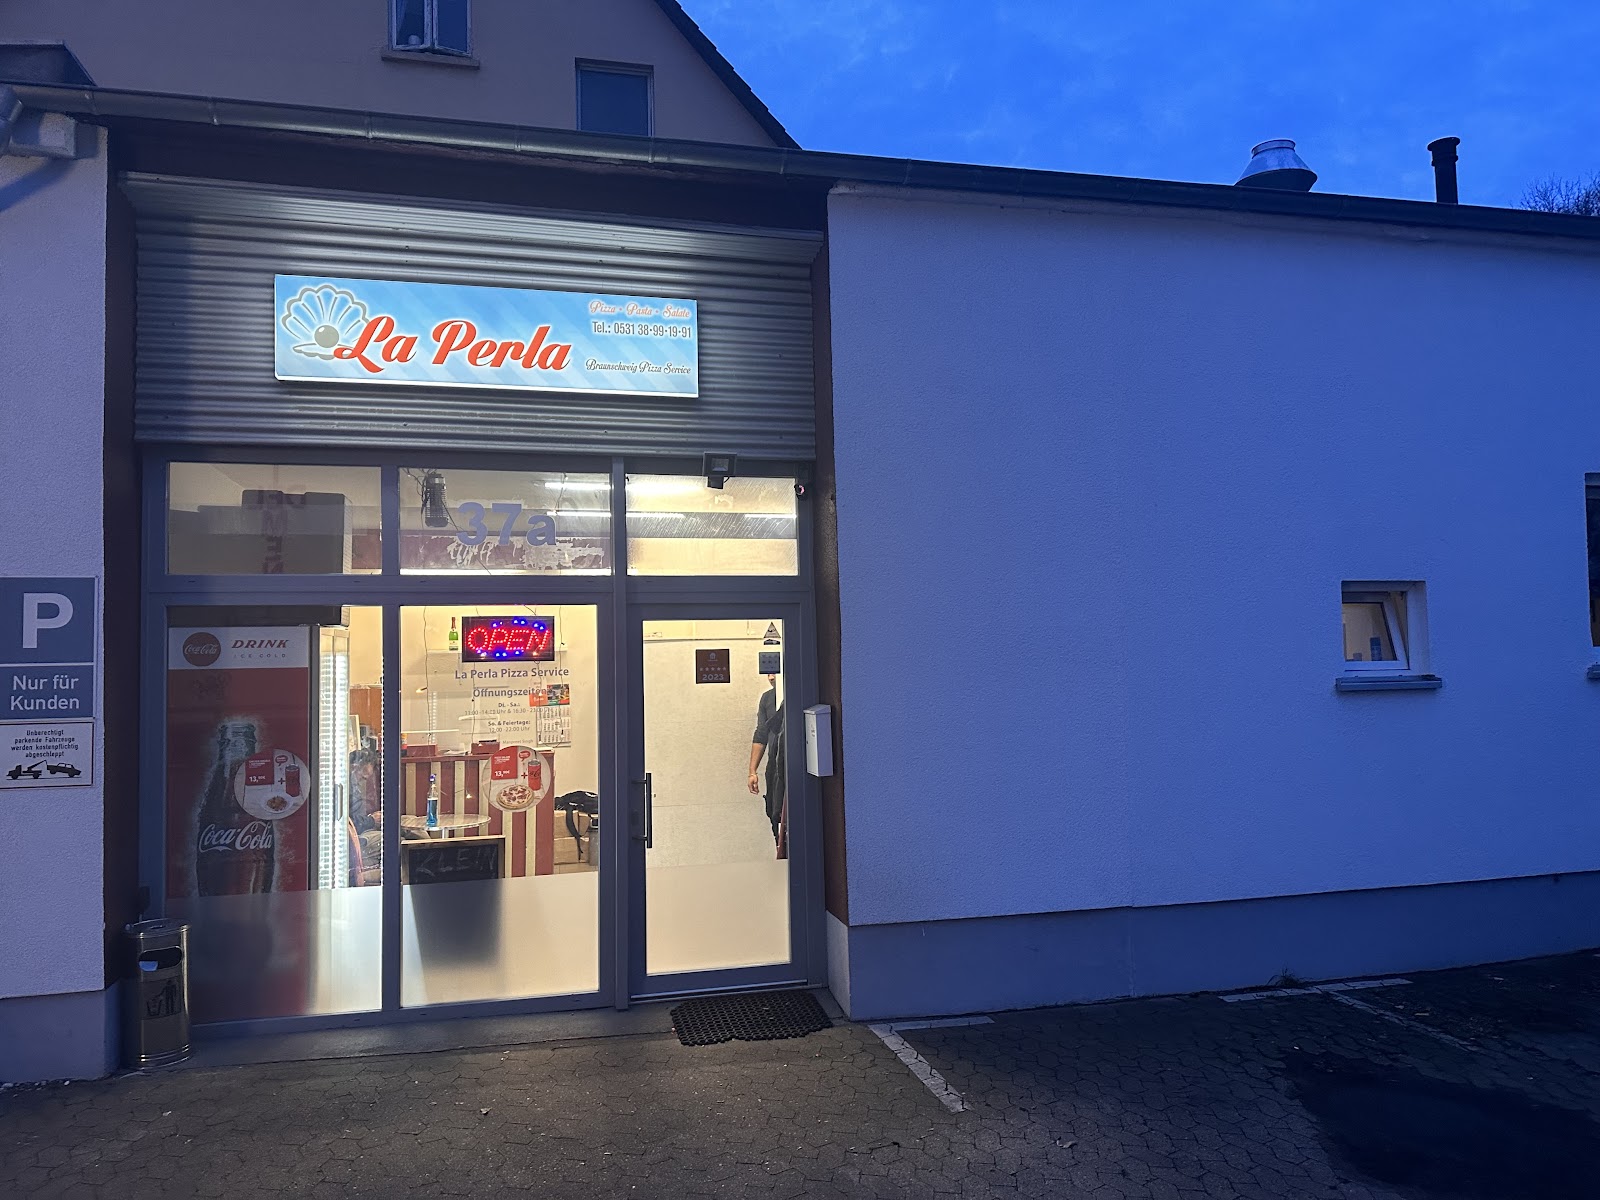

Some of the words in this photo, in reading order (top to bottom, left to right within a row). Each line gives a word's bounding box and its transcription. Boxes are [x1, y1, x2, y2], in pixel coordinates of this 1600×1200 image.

[589, 300, 616, 313] Pizza
[626, 303, 652, 316] Pasta
[662, 305, 690, 318] Salate
[592, 321, 611, 334] Tel.:
[614, 322, 635, 335] 0531
[333, 316, 418, 373] La
[432, 320, 572, 370] Perla
[586, 358, 638, 374] Braunschweig
[638, 361, 662, 373] Pizza
[664, 362, 692, 374] Service
[456, 501, 558, 548] 37a
[22, 592, 74, 648] P
[232, 640, 289, 648] DRINK
[467, 628, 550, 651] OPEN
[455, 670, 468, 680] La
[470, 669, 498, 679] Perla
[501, 668, 528, 678] Pizza
[531, 667, 569, 677] Service
[13, 676, 48, 690] Nur
[52, 675, 79, 690] für
[10, 696, 79, 710] Kunden
[36, 743, 79, 751] kostenpflichtig
[199, 821, 273, 853] Coca-Cola
